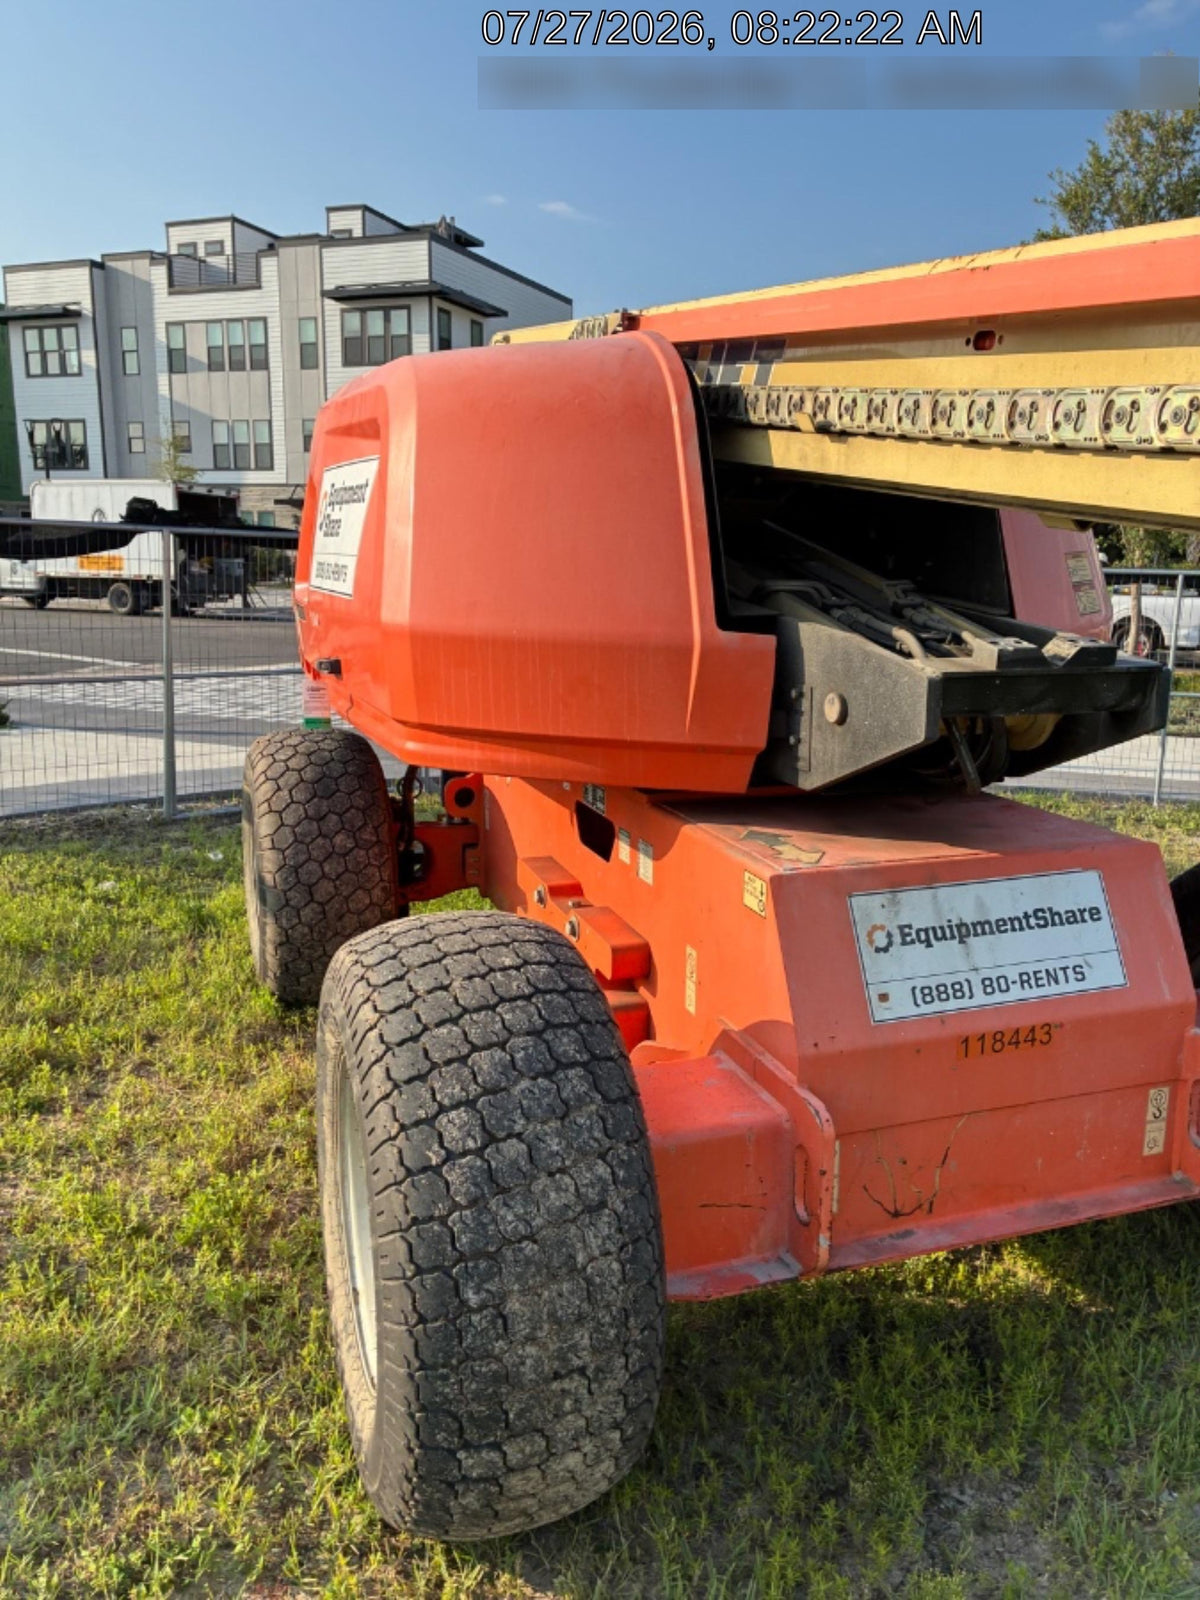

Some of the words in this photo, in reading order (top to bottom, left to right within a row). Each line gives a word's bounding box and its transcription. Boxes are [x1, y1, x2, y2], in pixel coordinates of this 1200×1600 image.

[898, 906, 1102, 948] EquipmentShare
[911, 979, 974, 1008] (888)
[981, 964, 1086, 996] 80-RENTS
[960, 1023, 1053, 1058] 118443
